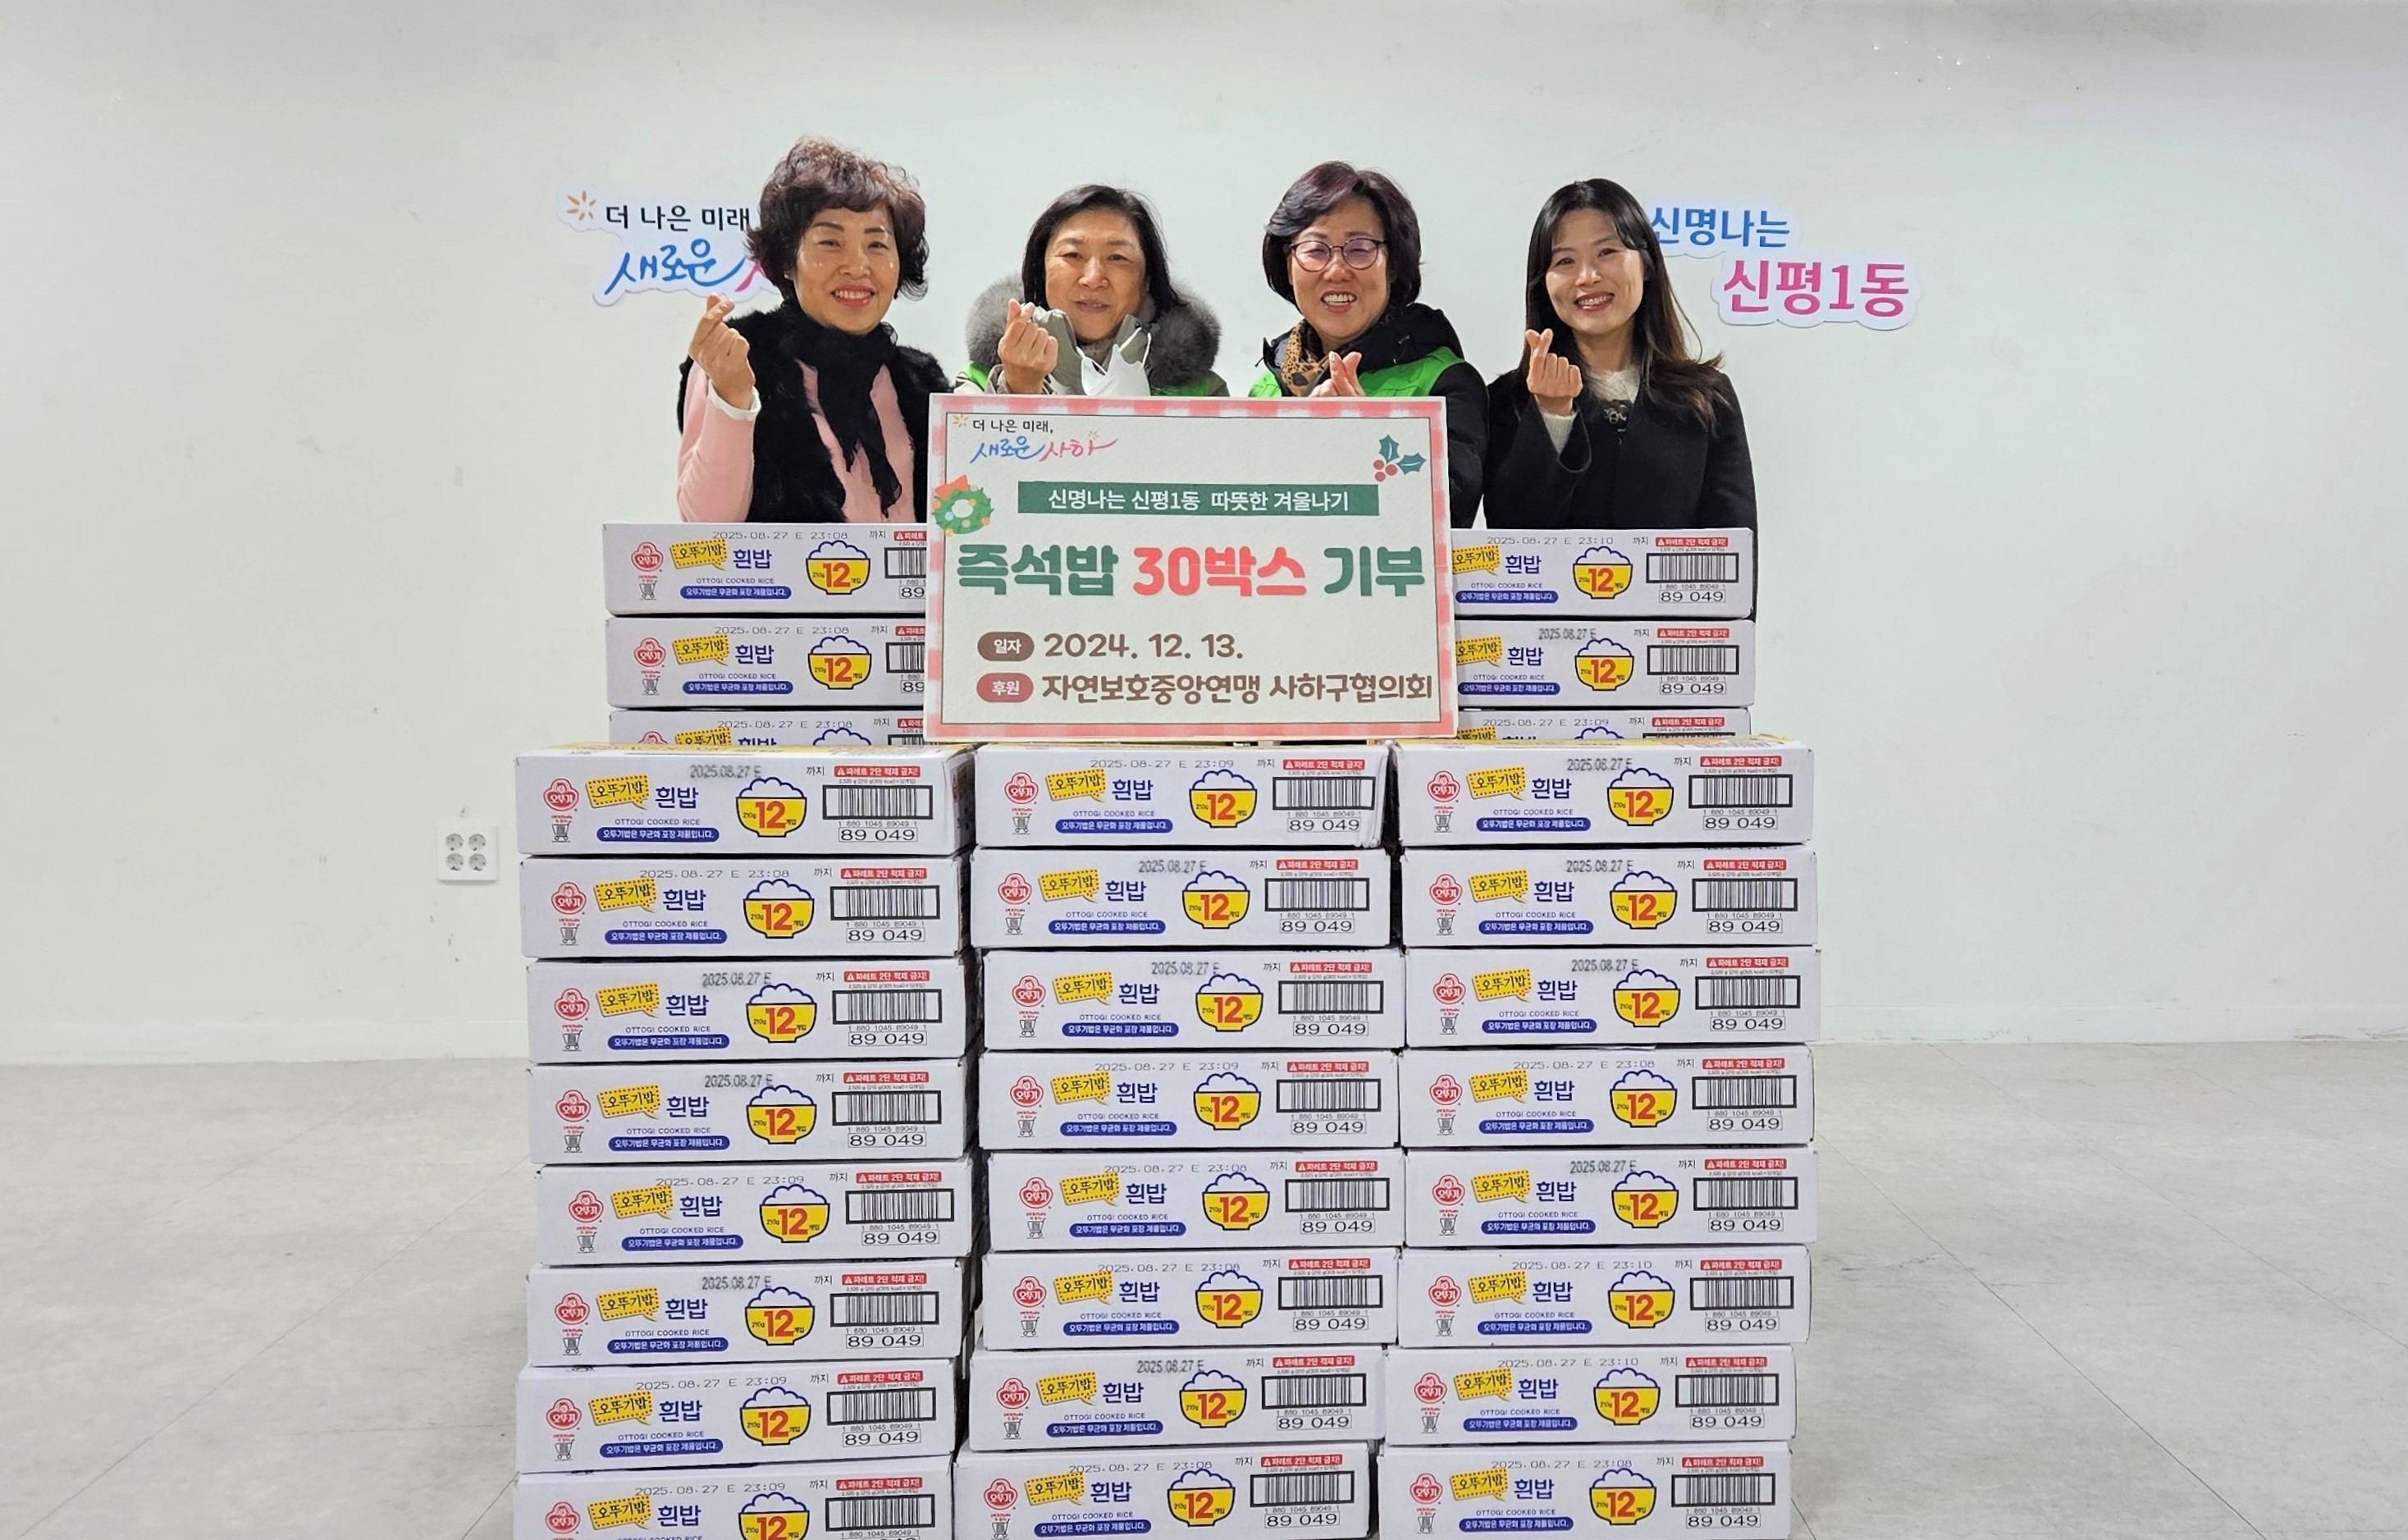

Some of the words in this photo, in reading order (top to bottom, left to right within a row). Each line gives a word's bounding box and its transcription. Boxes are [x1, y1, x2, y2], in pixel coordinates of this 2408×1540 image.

[605, 205, 628, 229] 더
[641, 205, 691, 231] 나은
[1651, 207, 1790, 248] 신명나는
[604, 239, 746, 295] 새로운
[1724, 260, 1909, 318] 신평1동
[972, 418, 986, 433] 더
[990, 418, 1017, 433] 나은
[1023, 419, 1054, 434] 미래,
[970, 436, 1045, 464] 새로운
[1040, 438, 1118, 463] 사하
[1048, 490, 1126, 510] 신명나는
[1131, 491, 1200, 511] 신평1동
[1211, 491, 1268, 512] 따뜻한
[1273, 491, 1350, 512] 겨울나기
[712, 531, 788, 540] 2025.08.27
[795, 531, 803, 540] E
[811, 531, 848, 540] 23:08
[677, 543, 723, 560] 오뚜기밥
[732, 548, 773, 569] 흰밥
[823, 560, 852, 587] 12
[957, 544, 1119, 596] 즉석밥
[1133, 546, 1307, 597] 30박스
[1323, 546, 1426, 598] 기부
[1505, 554, 1542, 575] 흰밥
[1588, 566, 1615, 592] 12
[1661, 591, 1683, 602] 89
[1689, 591, 1724, 601] 049
[734, 643, 774, 665] 흰밥
[993, 638, 1022, 655] 일자
[1044, 633, 1138, 658] 2024.
[1149, 633, 1190, 659] 12.
[1201, 633, 1244, 659] 13.
[1456, 641, 1498, 657] 오뚜기밥
[1506, 646, 1544, 666] 흰밥
[825, 656, 853, 682] 12
[1590, 658, 1617, 683] 12
[991, 679, 1021, 697] 후원
[1042, 673, 1260, 706] 자연보호중앙연맹
[1269, 673, 1433, 704] 사하구협의회
[717, 720, 793, 729] 2025.08.27
[800, 720, 808, 729] E
[816, 720, 852, 729] 23:08
[873, 718, 890, 728] 까지
[1483, 719, 1553, 728] 2025.08.27
[1559, 719, 1567, 727] E
[1574, 718, 1609, 727] 23:09
[1629, 716, 1645, 726] 까지
[594, 779, 644, 798] 오뚜기밥
[1053, 773, 1102, 791] 오뚜기밥
[1111, 779, 1154, 802] 흰밥
[1531, 776, 1573, 800] 흰밥
[655, 785, 699, 809] 흰밥
[1207, 792, 1237, 820] 12
[1624, 790, 1655, 818] 12
[755, 800, 786, 829] 12
[1705, 817, 1729, 829] 89
[1737, 816, 1775, 829] 049
[840, 829, 866, 841] 89
[875, 829, 915, 841] 049
[639, 870, 724, 879] 2025.08.27
[731, 870, 740, 878] E
[748, 870, 789, 878] 23:08
[813, 867, 832, 878] 까지
[1476, 875, 1524, 893] 오뚜기밥
[662, 888, 706, 912] 흰밥
[1003, 887, 1027, 898] 오뚜기
[1104, 880, 1147, 903] 흰밥
[1533, 880, 1575, 903] 흰밥
[762, 902, 794, 930] 12
[1199, 893, 1230, 921] 12
[1628, 893, 1658, 921] 12
[1281, 921, 1306, 932] 89
[1314, 920, 1352, 932] 049
[1060, 976, 1108, 994] 오뚜기밥
[1117, 982, 1160, 1005] 흰밥
[1537, 978, 1579, 1002] 흰밥
[560, 1003, 584, 1013] 오뚜기
[1631, 991, 1661, 1020] 12
[765, 1006, 797, 1035] 12
[605, 1090, 656, 1108] 오뚜기밥
[1116, 1081, 1158, 1104] 흰밥
[1434, 1088, 1457, 1099] 오뚜기
[666, 1094, 710, 1118] 흰밥
[1211, 1094, 1241, 1122] 12
[1628, 1091, 1658, 1120] 12
[765, 1107, 796, 1136] 12
[1292, 1122, 1318, 1133] 89
[1325, 1121, 1364, 1133] 049
[1104, 1164, 1184, 1174] 2025.08.27
[1191, 1164, 1199, 1172] E
[1208, 1163, 1248, 1172] 23:08
[1269, 1161, 1287, 1172] 까지
[1125, 1181, 1167, 1205] 흰밥
[1478, 1175, 1526, 1193] 오뚜기밥
[1536, 1180, 1578, 1203] 흰밥
[679, 1195, 723, 1218] 흰밥
[1220, 1195, 1250, 1222] 12
[1629, 1192, 1660, 1220] 12
[778, 1206, 810, 1235] 12
[1710, 1219, 1735, 1232] 89
[1743, 1218, 1780, 1231] 049
[863, 1232, 889, 1245] 89
[898, 1231, 937, 1244] 049
[1512, 1261, 1591, 1270] 2025.08.27
[1597, 1261, 1606, 1269] E
[1613, 1260, 1652, 1269] 23:10
[1061, 1276, 1108, 1295] 오뚜기밥
[1118, 1280, 1161, 1304] 흰밥
[1532, 1280, 1574, 1304] 흰밥
[665, 1297, 708, 1321] 흰밥
[1213, 1292, 1244, 1320] 12
[624, 1329, 655, 1337] OTTOGI
[656, 1328, 689, 1337] COOKED
[692, 1328, 710, 1337] RICE
[1102, 1381, 1145, 1405] 흰밥
[1518, 1378, 1560, 1401] 흰밥
[597, 1396, 648, 1416] 오뚜기밥
[658, 1399, 702, 1423] 흰밥
[1197, 1391, 1227, 1420] 12
[1611, 1390, 1641, 1418] 12
[758, 1408, 790, 1438] 12
[1063, 1413, 1092, 1422] OTTOGI
[1094, 1412, 1126, 1420] COOKED
[1128, 1411, 1145, 1419] RICE
[1692, 1415, 1716, 1428] 89
[1724, 1415, 1761, 1427] 049
[844, 1433, 870, 1446] 89
[879, 1430, 919, 1444] 049
[1456, 1473, 1504, 1492] 오뚜기밥
[1514, 1478, 1556, 1501] 흰밥
[1185, 1490, 1215, 1519] 12
[1607, 1489, 1637, 1517] 12
[657, 1503, 701, 1528] 흰밥
[757, 1514, 788, 1540] 12
[1266, 1515, 1291, 1527] 89
[1299, 1513, 1337, 1526] 049
